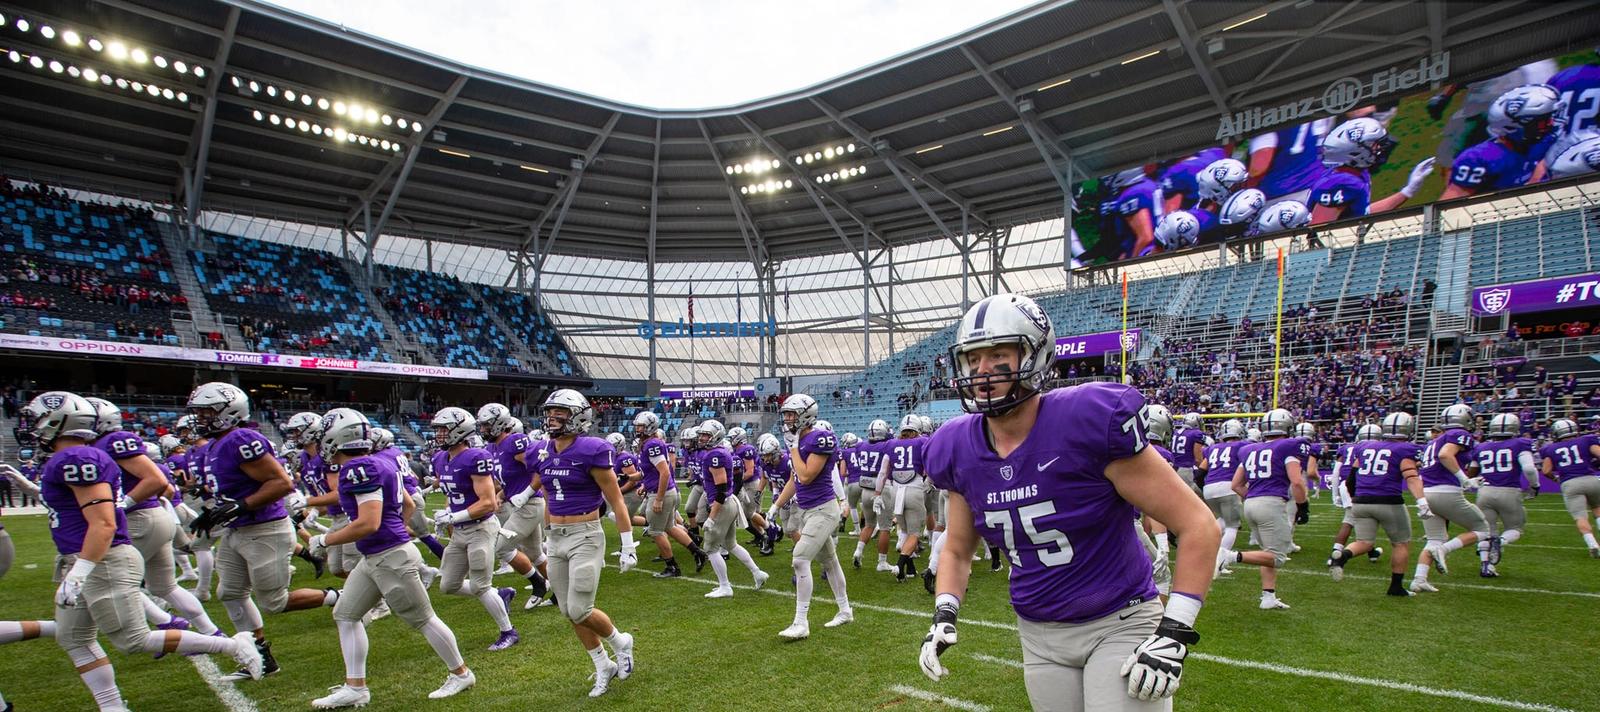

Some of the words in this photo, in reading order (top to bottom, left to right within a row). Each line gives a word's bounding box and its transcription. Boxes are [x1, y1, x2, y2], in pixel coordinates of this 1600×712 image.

[1216, 97, 1317, 141] Allianz
[1371, 51, 1450, 98] Field
[661, 316, 777, 338] element
[59, 341, 141, 354] OPPIDAN
[219, 353, 263, 364] TOMMIE
[315, 358, 355, 369] JOHNNIE
[402, 366, 451, 376] OPPIDAN
[1121, 403, 1150, 454] 75
[239, 440, 265, 459] 62
[514, 437, 529, 450] 57
[817, 436, 834, 448] 35
[1171, 434, 1187, 454] 12
[1457, 434, 1470, 446] 41
[648, 446, 661, 456] 55
[860, 450, 880, 472] 27
[893, 445, 914, 469] 31
[1208, 446, 1232, 469] 44
[1480, 448, 1513, 474] 20
[1555, 444, 1584, 467] 31
[477, 459, 493, 472] 25
[712, 457, 719, 466] 9
[1244, 448, 1273, 479] 49
[1358, 448, 1392, 476] 36
[63, 464, 97, 481] 28
[346, 466, 369, 484] 41
[552, 478, 564, 501] 1
[987, 493, 999, 505] ST.
[1000, 484, 1038, 503] THOMAS
[983, 499, 1075, 568] 75
